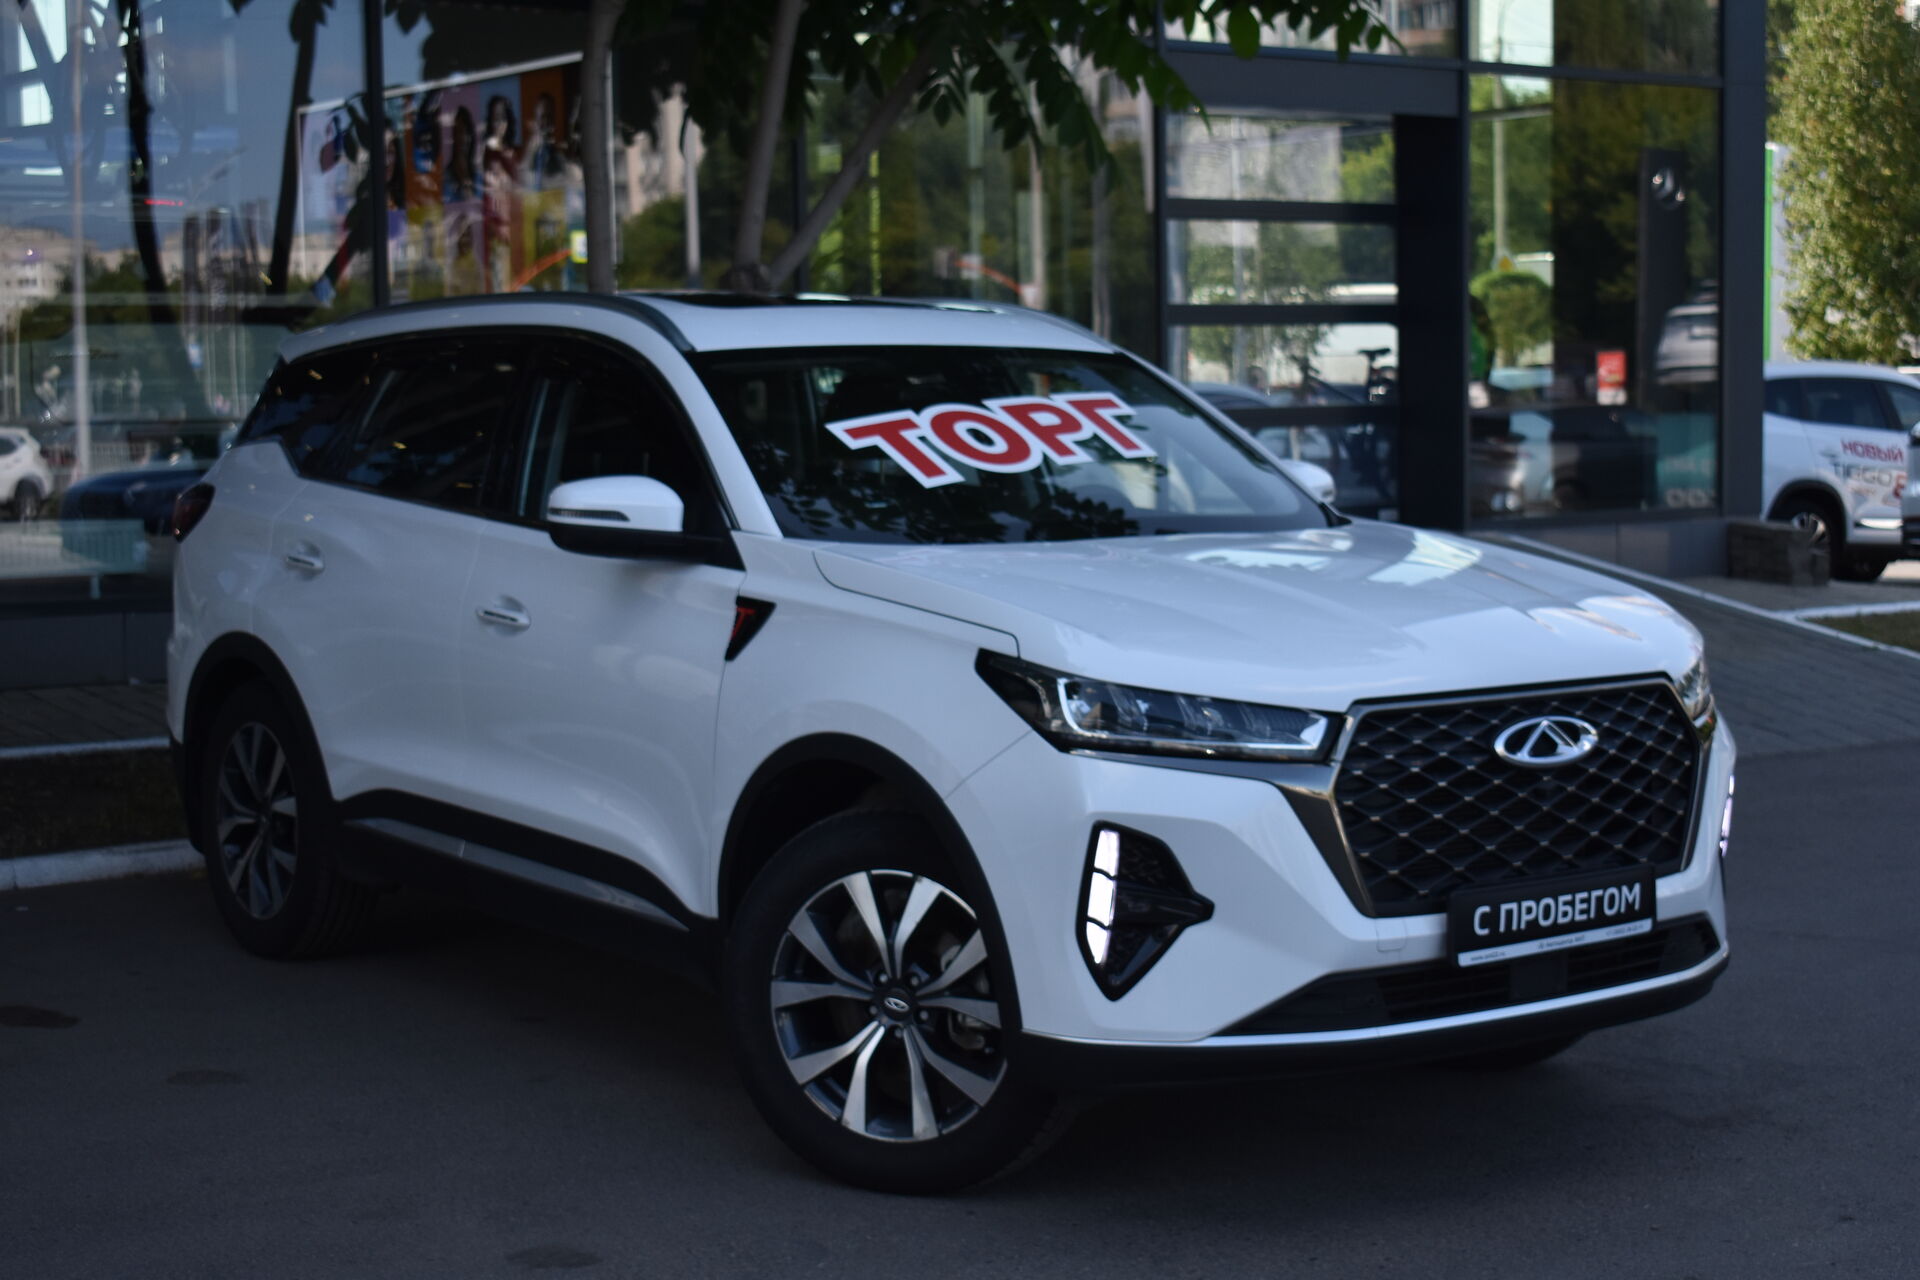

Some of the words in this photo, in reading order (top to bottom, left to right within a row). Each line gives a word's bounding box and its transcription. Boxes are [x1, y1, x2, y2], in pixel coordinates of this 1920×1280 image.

[826, 392, 1157, 488] ТОРГ
[1841, 440, 1904, 463] НОВЫЙ
[1473, 905, 1492, 936] С
[1499, 882, 1641, 933] ПРОБЕГОМ
